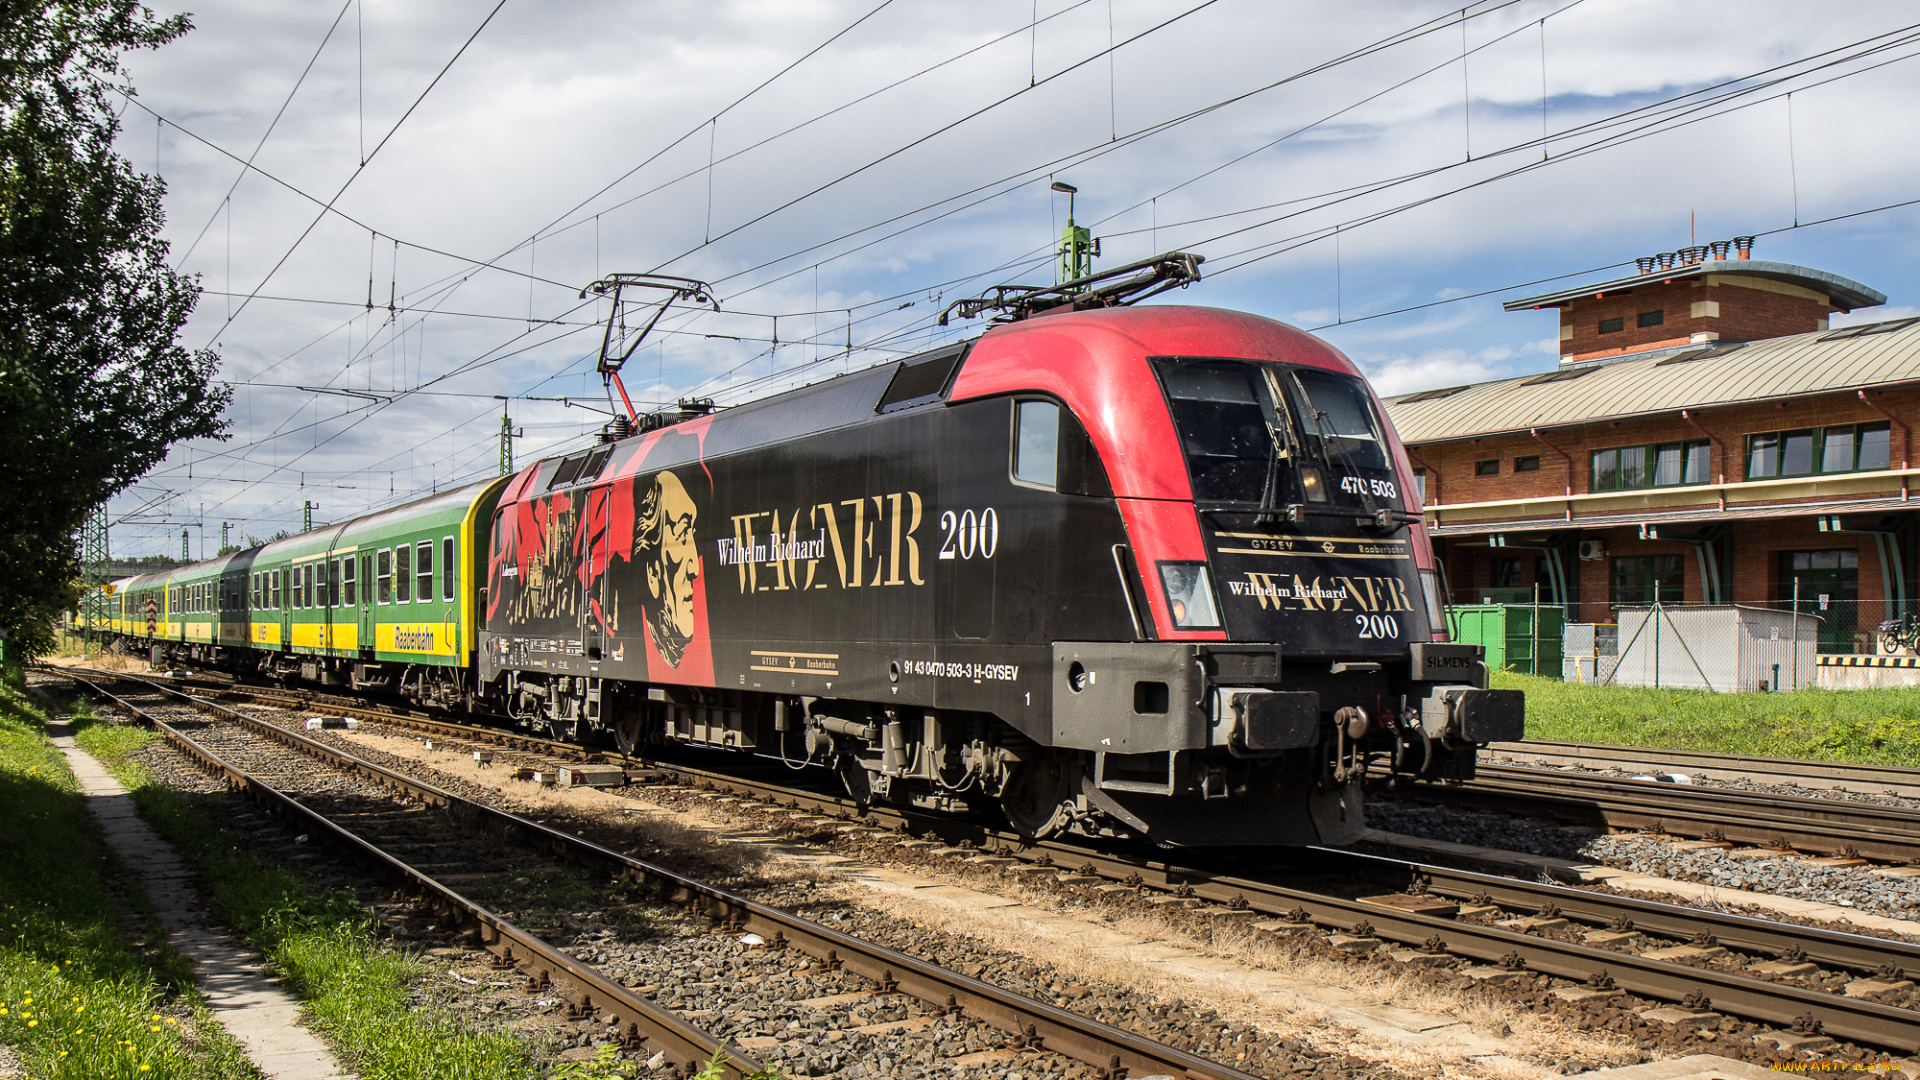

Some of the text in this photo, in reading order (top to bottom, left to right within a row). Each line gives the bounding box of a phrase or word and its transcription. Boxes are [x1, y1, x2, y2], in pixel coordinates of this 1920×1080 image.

[1341, 476, 1397, 498] 470 503
[731, 491, 925, 594] WAGNER
[939, 507, 998, 560] 200
[717, 527, 825, 566] Wilhelm Richard
[1251, 539, 1293, 550] GYSEV
[106, 585, 113, 594] 8
[1228, 581, 1348, 599] Wilhelm Richard
[1244, 571, 1414, 612] WAGNER
[1355, 614, 1399, 639] 200
[395, 626, 433, 650] Raaberbahn
[761, 656, 779, 666] GYSEV
[904, 661, 1019, 682] 91 43 0470 503-3 H-GYSEV
[1426, 656, 1470, 668] SIEMENS
[1025, 691, 1031, 706] 1
